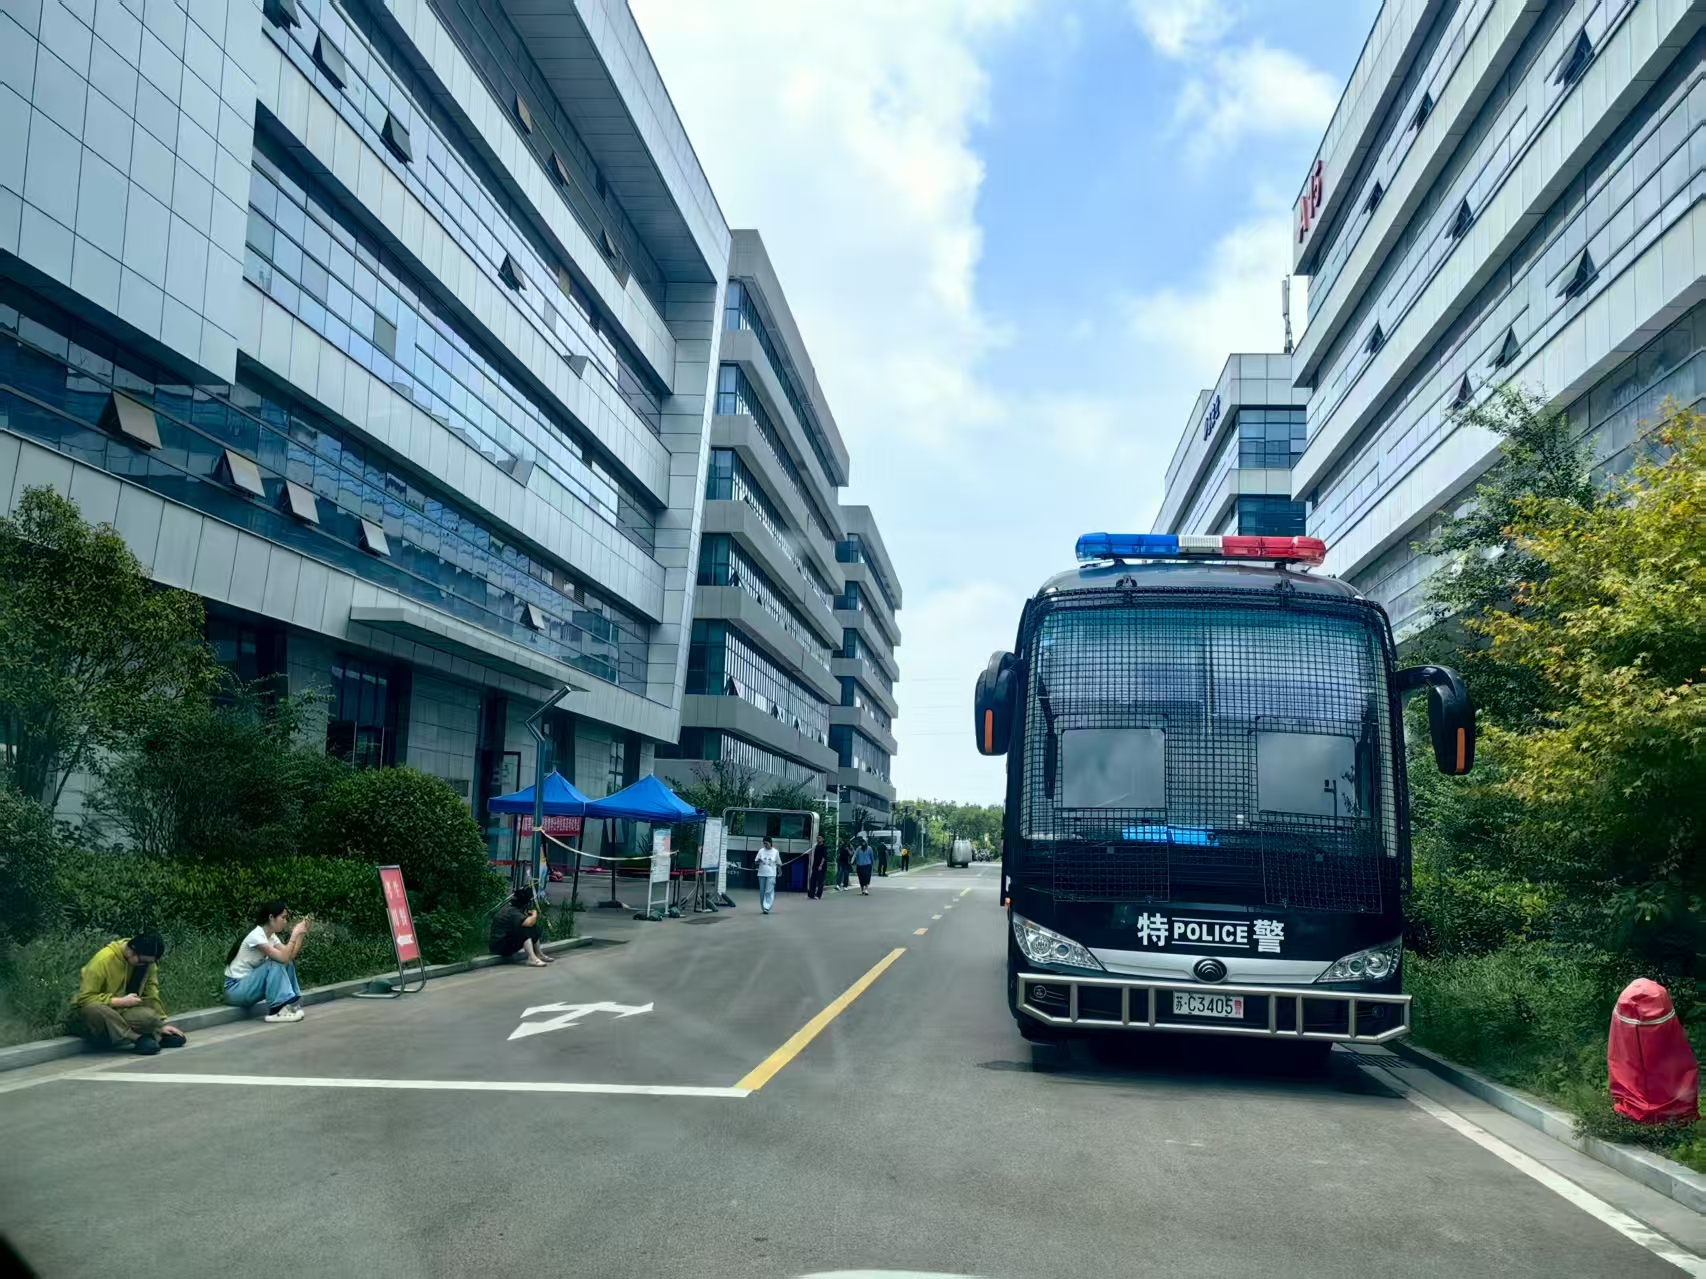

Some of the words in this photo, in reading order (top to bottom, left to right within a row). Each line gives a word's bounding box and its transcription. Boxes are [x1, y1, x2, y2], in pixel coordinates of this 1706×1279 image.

[1136, 912, 1169, 947] 特
[1173, 922, 1248, 944] POLICE
[1253, 919, 1285, 953] 警
